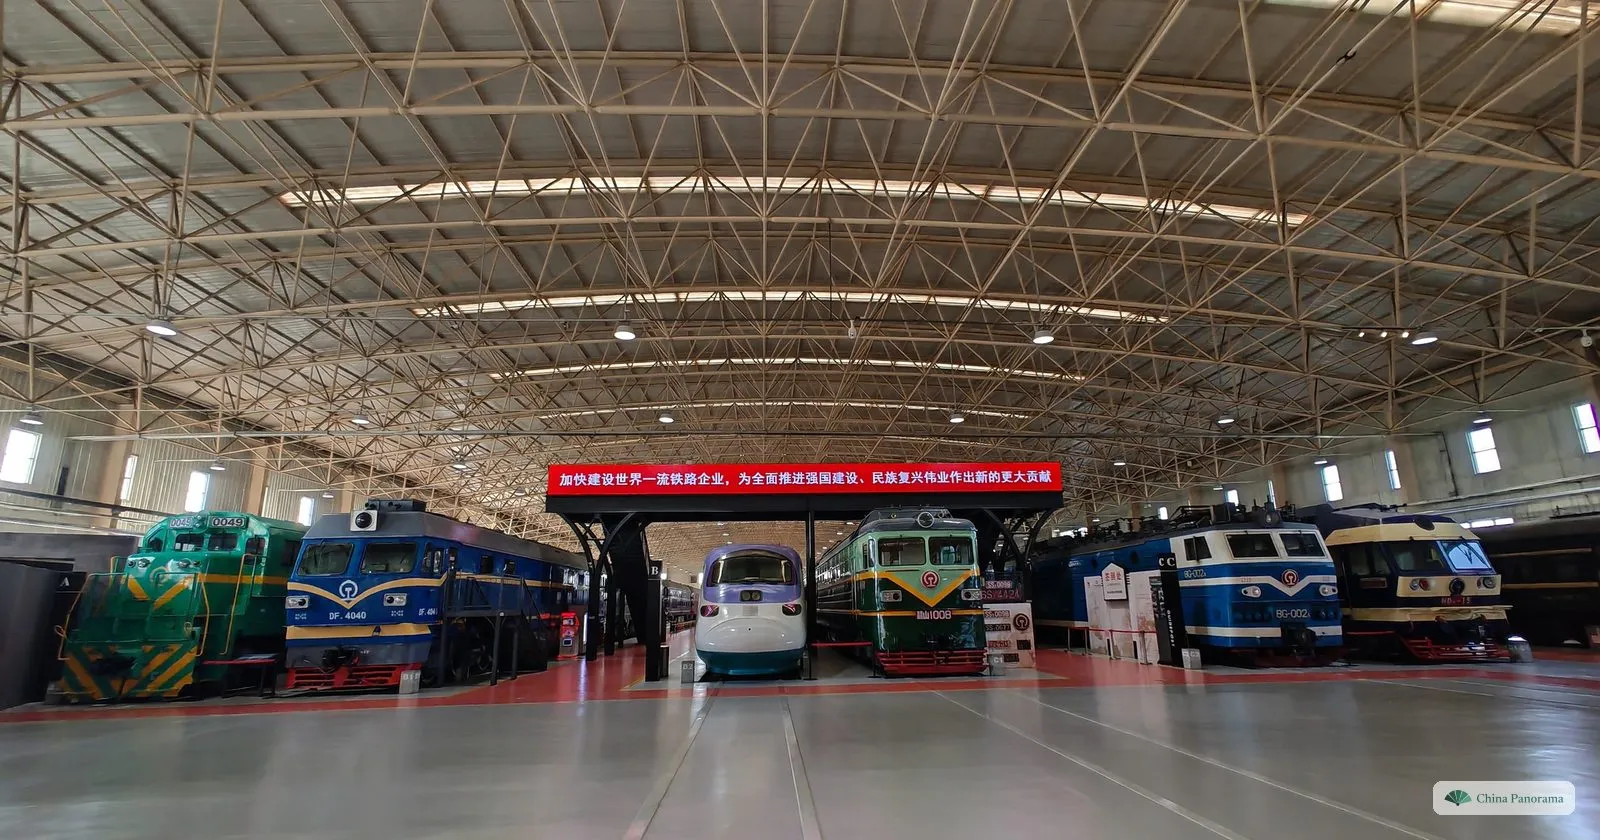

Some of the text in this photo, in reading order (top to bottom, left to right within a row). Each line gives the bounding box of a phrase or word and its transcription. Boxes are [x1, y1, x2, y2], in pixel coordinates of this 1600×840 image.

[558, 470, 1053, 487] 加快建设世界一流铁路企业，为全面推进强国建设、民族复兴伟业作出新的更大贡献
[170, 518, 192, 527] 0049
[212, 517, 244, 527] 0049
[1167, 557, 1176, 567] C
[651, 566, 659, 575] B
[60, 576, 70, 587] A
